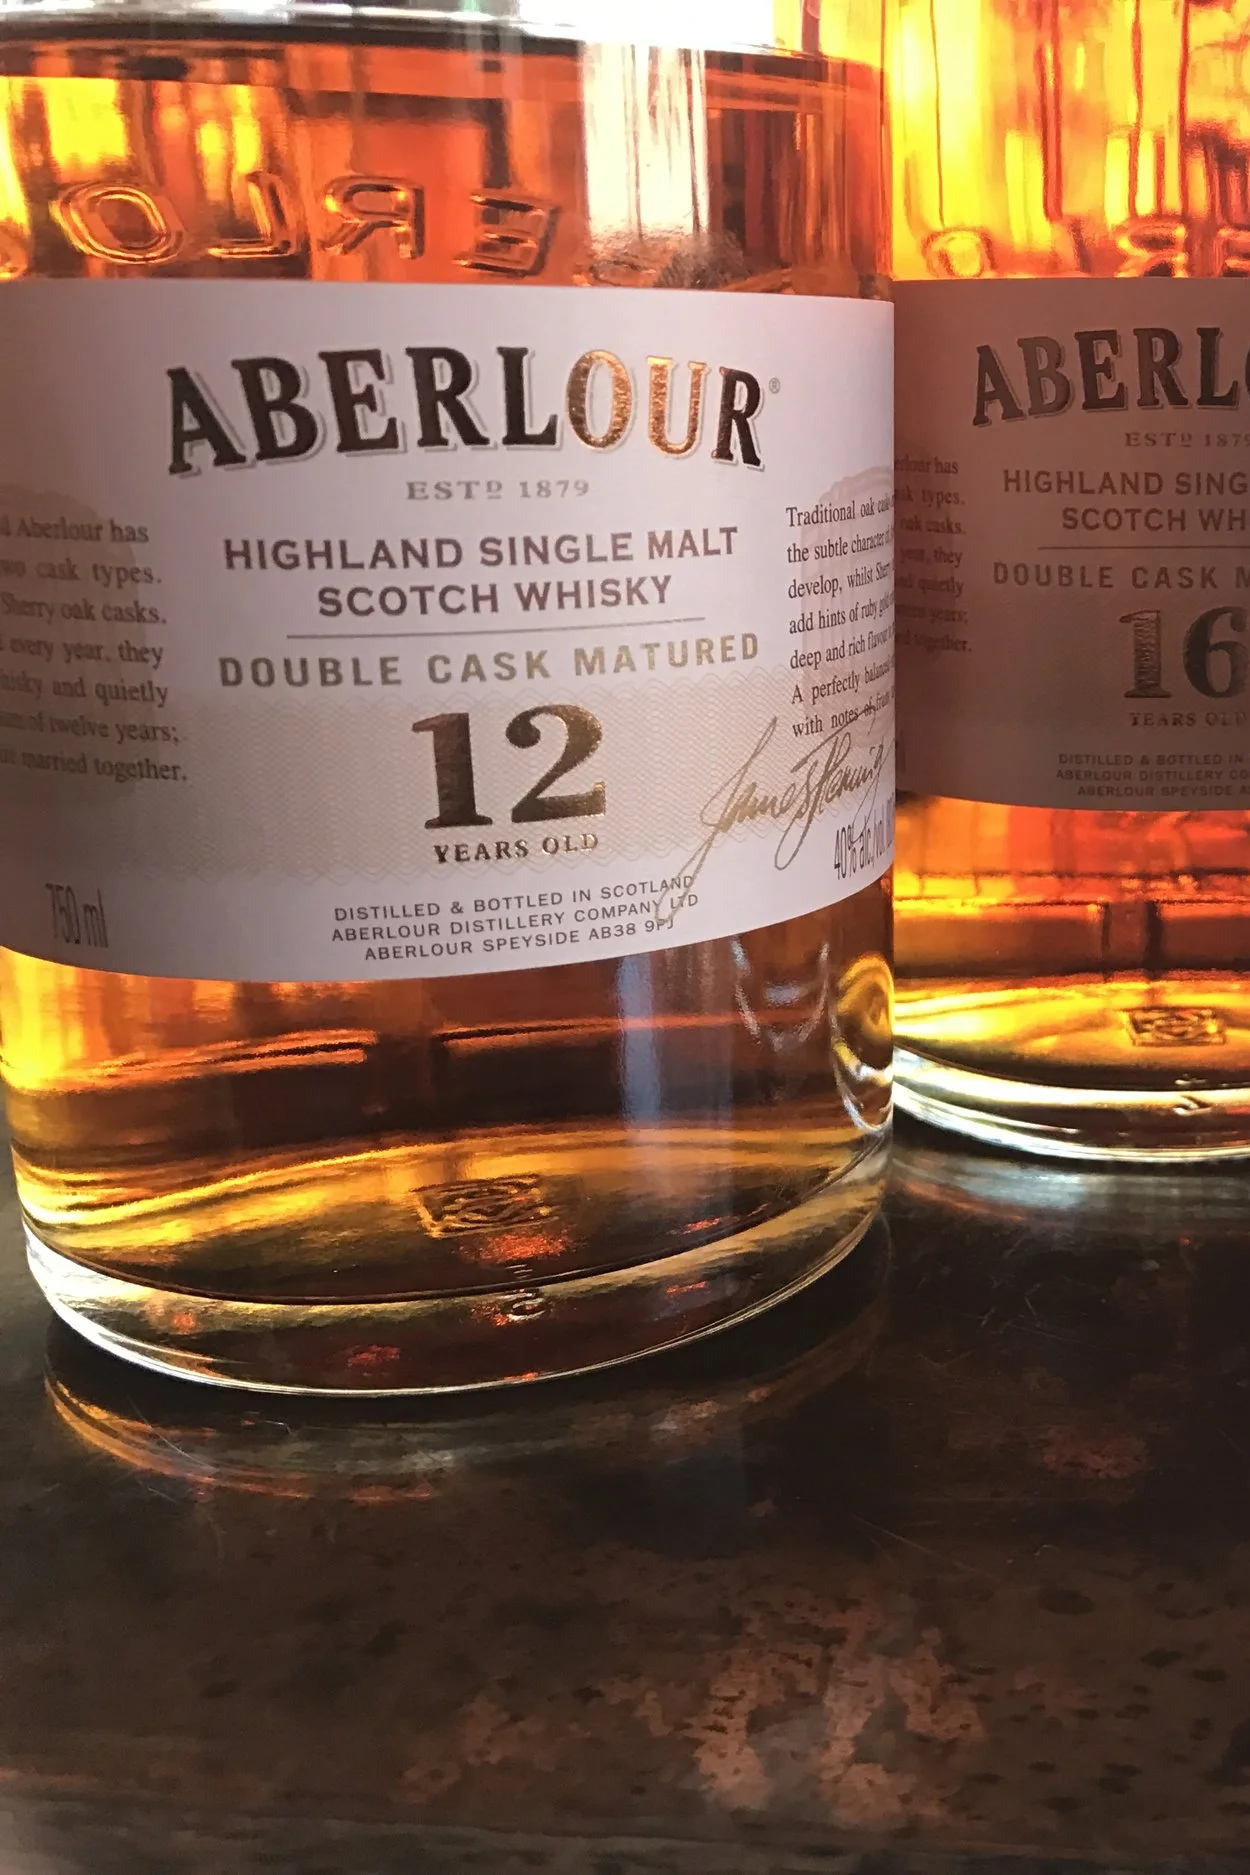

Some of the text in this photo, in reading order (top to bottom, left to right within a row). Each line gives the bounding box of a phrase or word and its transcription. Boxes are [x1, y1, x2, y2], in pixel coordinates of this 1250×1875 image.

[167, 346, 766, 475] ABERLOUR
[934, 455, 959, 474] has
[519, 478, 590, 498] 1879
[1003, 468, 1164, 496] HIGHLAND
[785, 499, 856, 528] Traditional
[860, 497, 875, 518] oak
[1061, 505, 1187, 532] SCOTCH
[110, 518, 149, 543] has
[224, 526, 738, 570] HIGHLAND SINGLE MALT
[786, 543, 810, 563] the
[814, 536, 848, 561] subtle
[851, 533, 885, 554] character
[933, 546, 963, 568] they
[35, 557, 162, 589] cask types.
[788, 574, 842, 599] develop,
[846, 566, 873, 588] whilst
[993, 561, 1114, 590] DOUBLE
[1131, 565, 1220, 591] CASK
[61, 598, 167, 624] oak casks.
[317, 575, 673, 617] SCOTCH WHISKY
[789, 611, 814, 634] add
[818, 608, 846, 630] hints
[849, 601, 860, 622] of
[117, 640, 164, 669] they
[219, 632, 760, 688] DOUBLE CASK MATURED
[790, 634, 866, 670] deep and rich
[53, 677, 168, 708] and quietly
[791, 684, 803, 705] A
[811, 670, 860, 706] perfectly
[115, 723, 179, 745] years;
[792, 707, 859, 737] with notes
[1129, 712, 1197, 727] YEARS
[94, 758, 187, 783] together.
[411, 703, 607, 830] 12
[1058, 753, 1243, 766] DISTILLED BOTTLED IN
[1056, 769, 1223, 782] ABERLOUR DISTILLERY
[1077, 784, 1233, 798] ABERLOUR SPEYSIDE
[433, 833, 599, 864] YEARS OLD
[334, 875, 693, 921] DISTILLED & BOTTLED IN SCOTLAND
[45, 882, 109, 948] 750 ml
[331, 893, 699, 942] ABERLOUR DISTILLERY COMPANY LTD
[364, 942, 473, 961] ABERLOUR
[483, 931, 580, 952] SPEYSIDE
[589, 923, 637, 941] AB38
